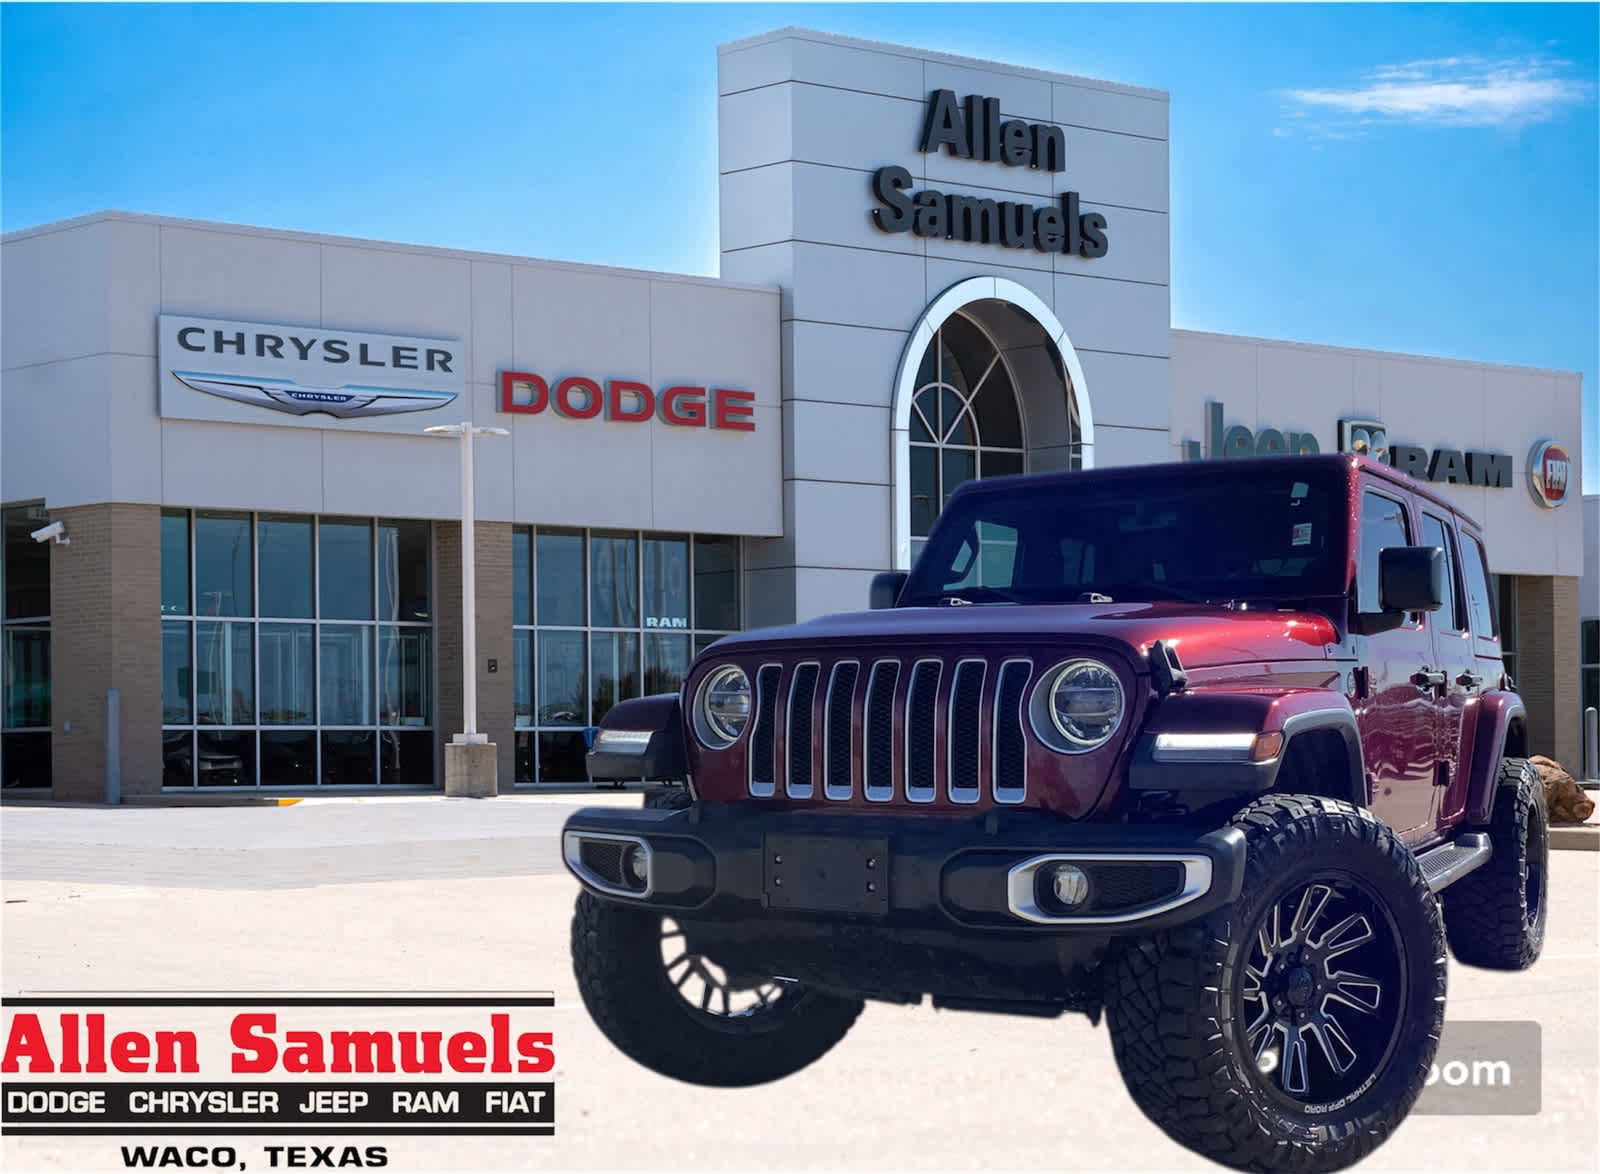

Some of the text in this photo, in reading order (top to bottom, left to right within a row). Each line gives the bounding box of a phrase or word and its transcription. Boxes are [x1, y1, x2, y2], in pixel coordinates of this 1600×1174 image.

[918, 89, 1066, 172] Allen
[872, 165, 1108, 258] Samuels
[177, 327, 453, 373] CHRYSLER
[291, 392, 347, 401] CHRYSLER
[497, 370, 756, 432] DODGE
[1390, 446, 1513, 488] RAM
[1546, 460, 1567, 489] FIAT
[646, 616, 687, 628] RAM
[1303, 1104, 1328, 1114] ROAD
